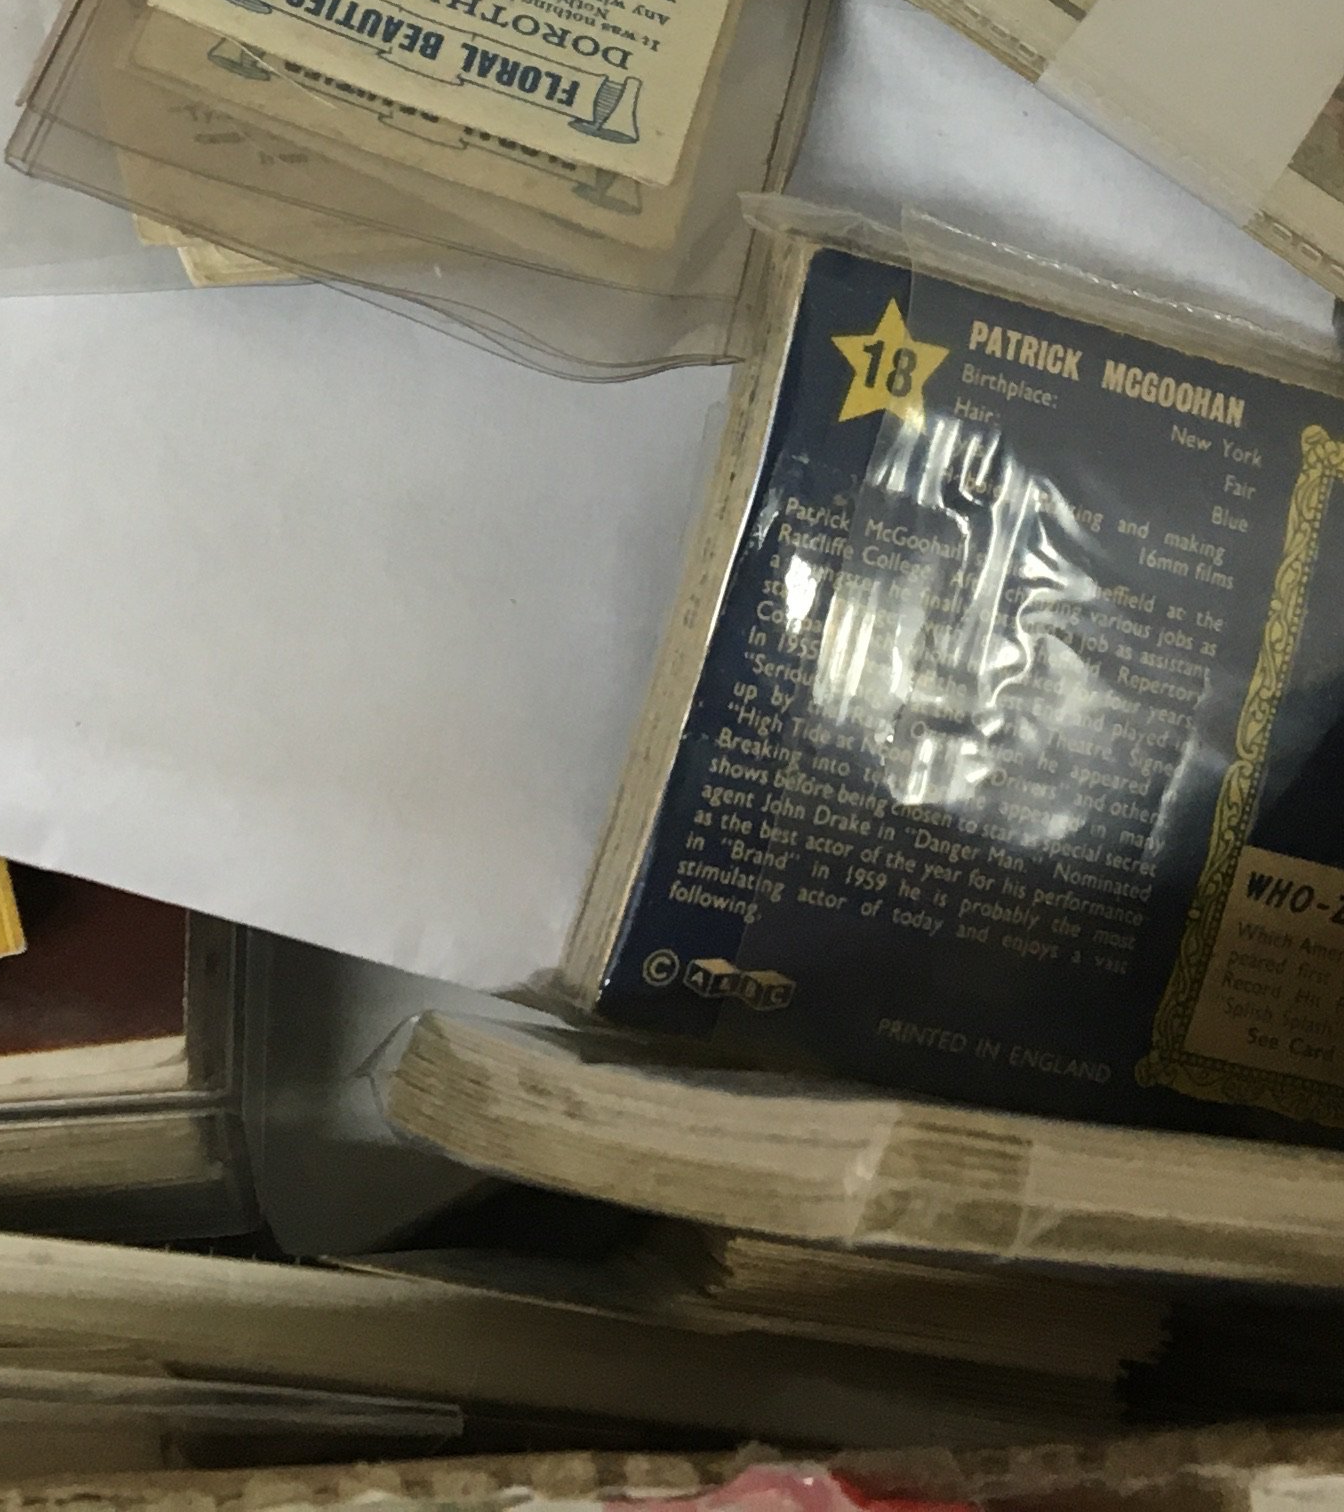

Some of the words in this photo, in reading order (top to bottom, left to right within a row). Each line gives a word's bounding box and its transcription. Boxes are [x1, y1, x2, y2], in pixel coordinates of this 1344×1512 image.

[461, 43, 579, 107] FLORAL
[862, 340, 918, 397] 18
[961, 363, 1059, 409] Birthplace:
[969, 320, 1083, 381] PATRICK
[1101, 359, 1245, 429] MCGOOHAN
[954, 397, 1001, 425] Hair:
[1170, 424, 1213, 452] New
[1222, 439, 1263, 469] York
[1224, 474, 1257, 498] Fair
[1117, 517, 1150, 541] and
[1164, 531, 1225, 566] making
[1212, 506, 1249, 532] Blue
[1138, 547, 1190, 576] 16mm
[1195, 563, 1235, 591] films
[669, 880, 762, 924] following.
[878, 1017, 966, 1053] PRINTED
[975, 1038, 1000, 1061] IN
[1009, 1046, 1111, 1084] ENGLAND
